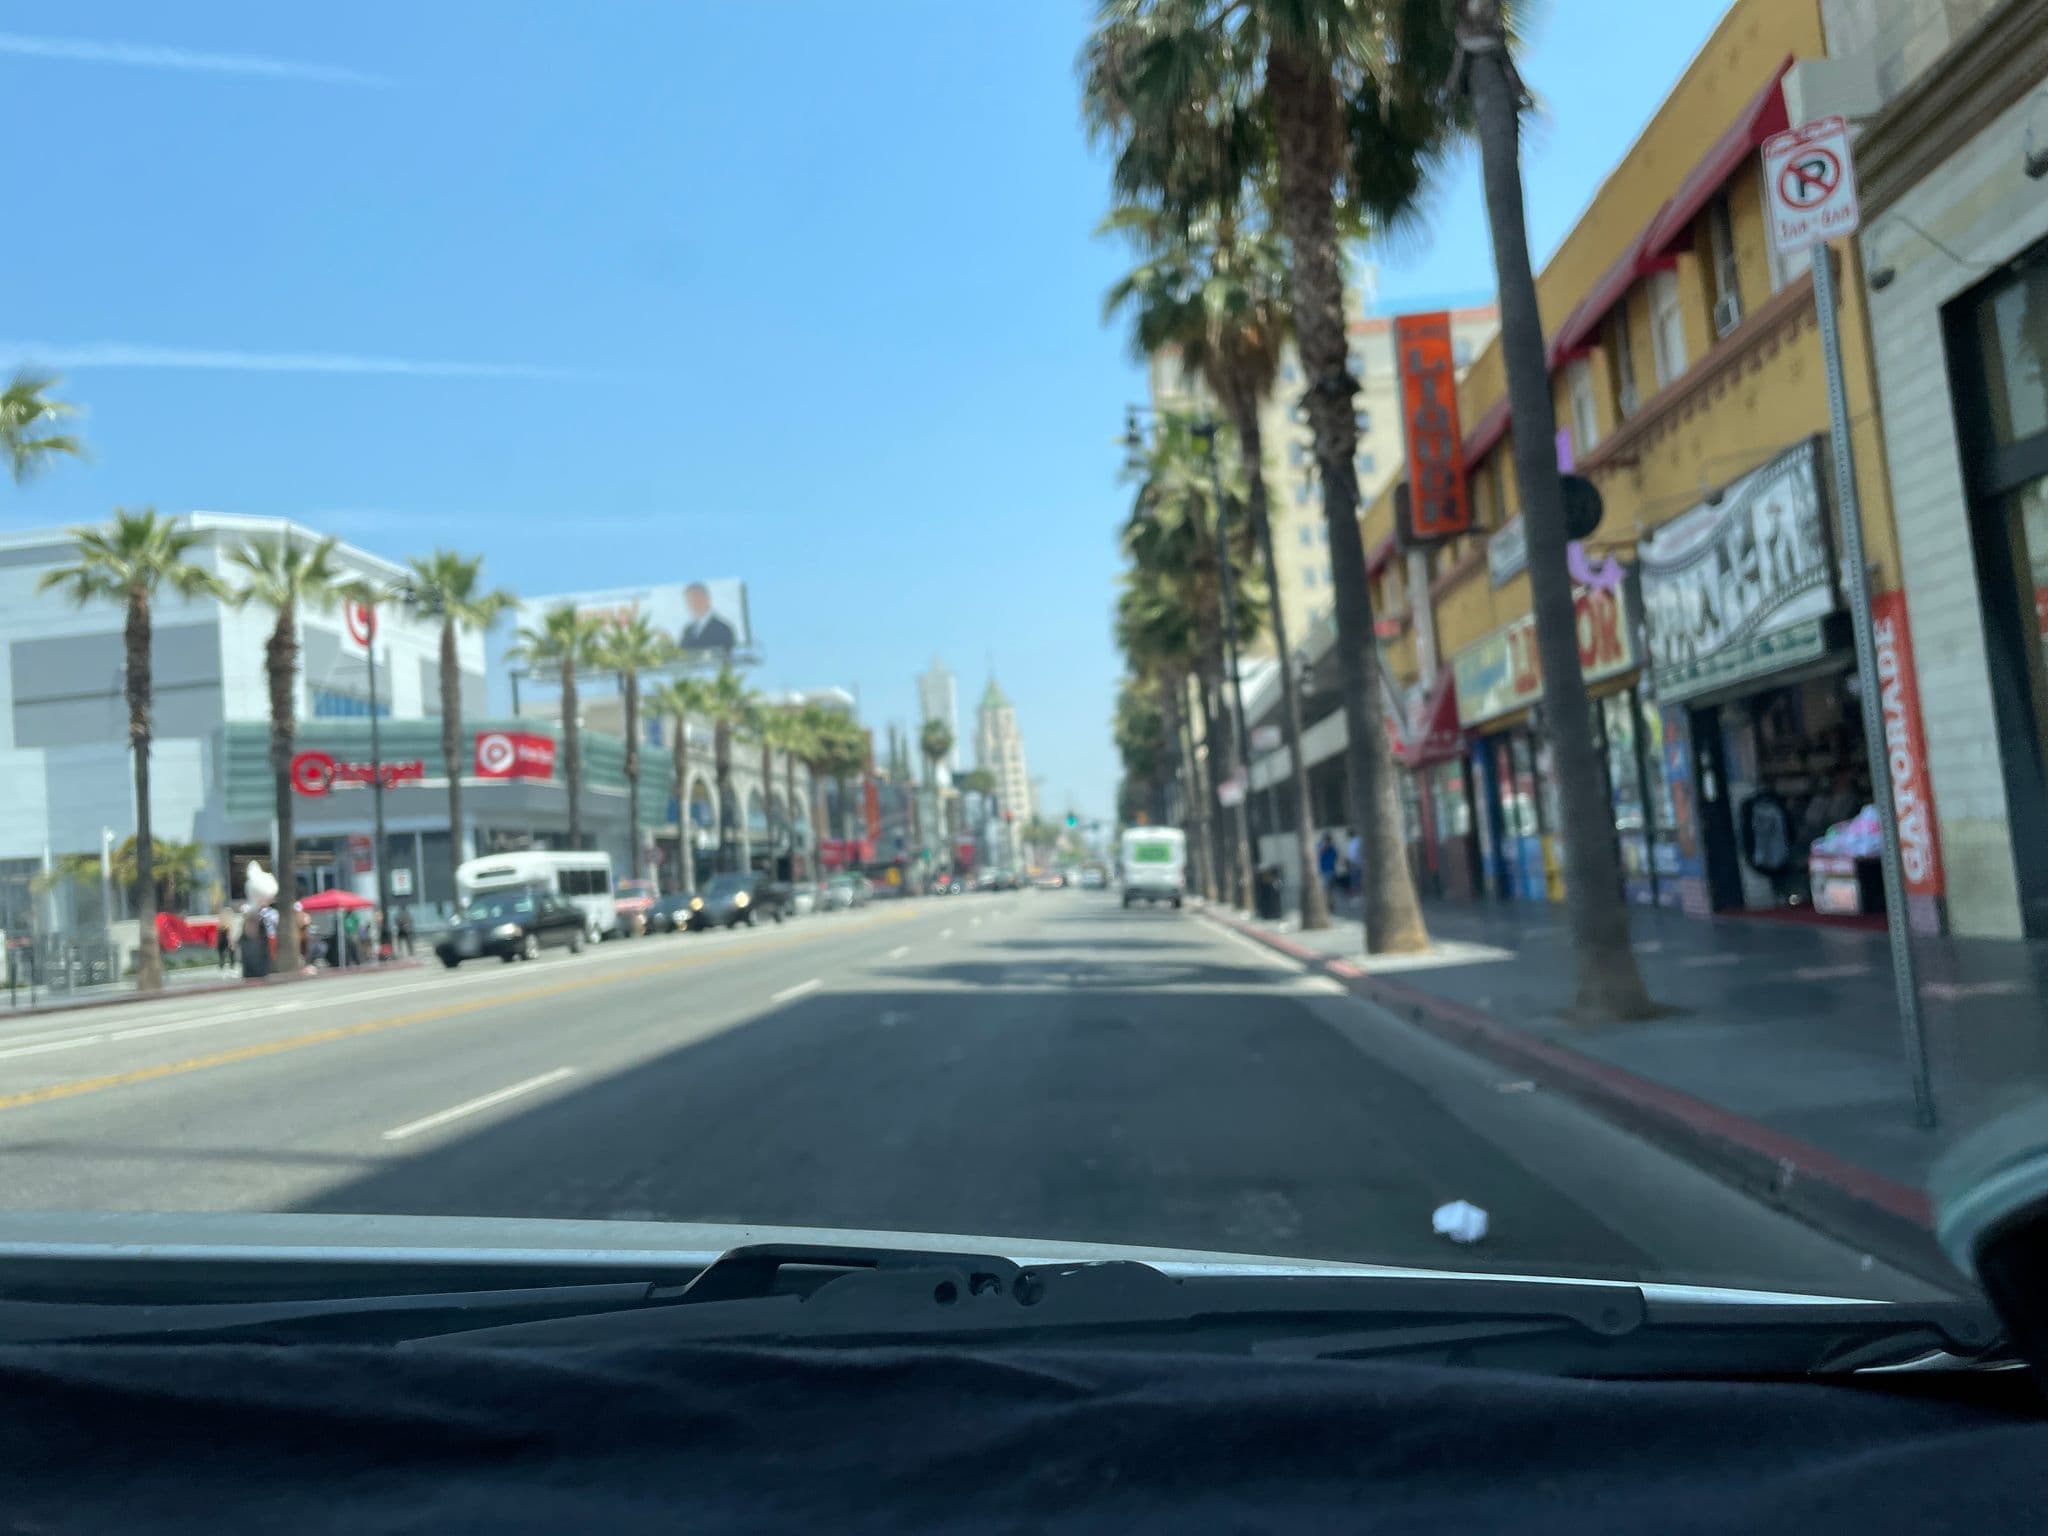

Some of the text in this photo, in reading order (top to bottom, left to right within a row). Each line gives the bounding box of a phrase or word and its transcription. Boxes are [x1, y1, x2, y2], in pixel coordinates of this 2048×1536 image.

[1408, 347, 1458, 524] LIQUOR
[1509, 588, 1623, 695] LIOR
[1872, 616, 1926, 886] GATORADE
